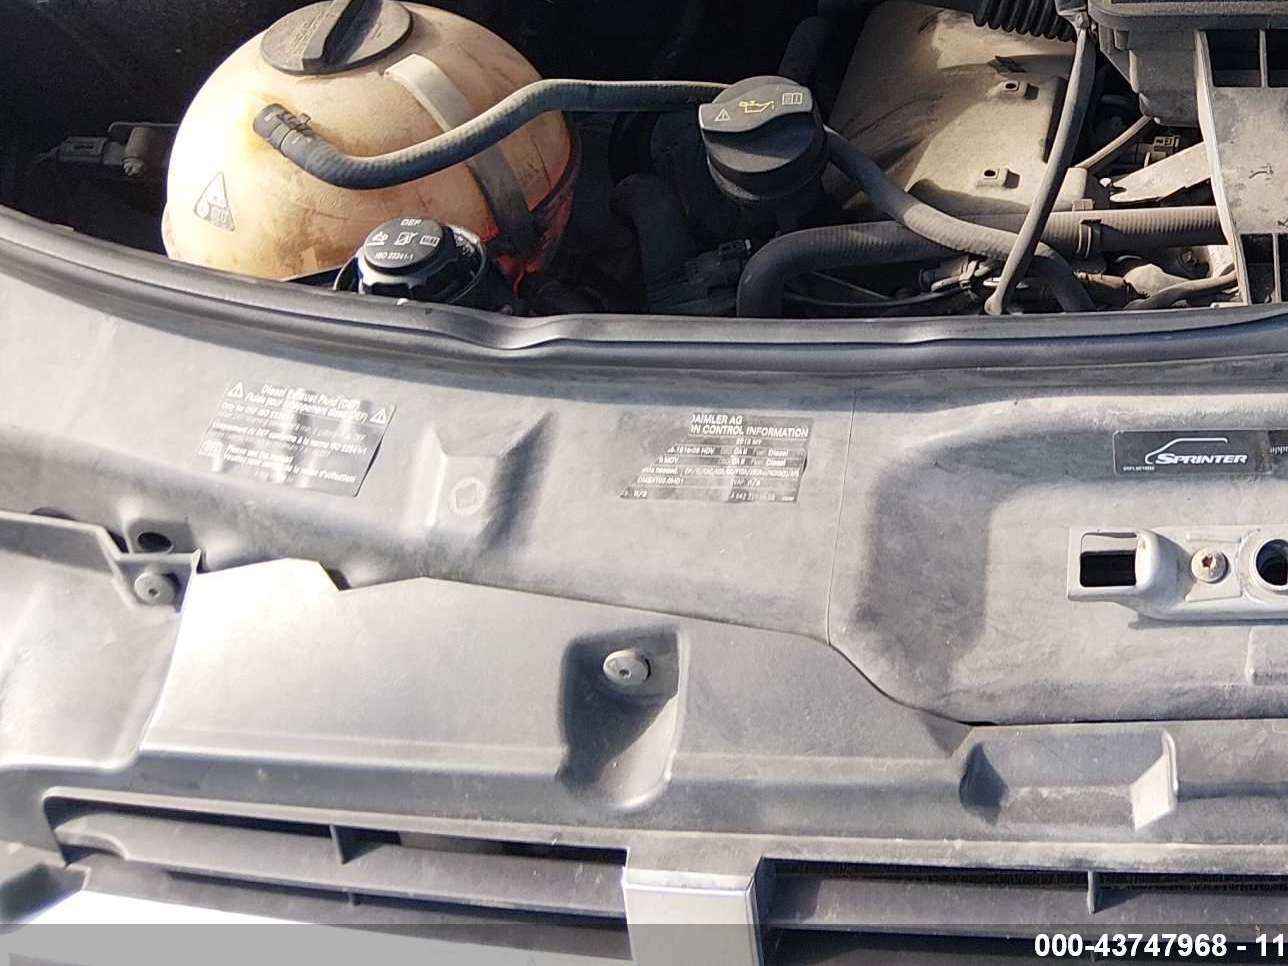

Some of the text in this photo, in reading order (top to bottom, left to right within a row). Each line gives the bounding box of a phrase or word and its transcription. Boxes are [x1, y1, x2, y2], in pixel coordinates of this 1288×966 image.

[400, 218, 422, 226] DEF
[260, 384, 287, 397] Diesel
[317, 394, 339, 408] Fluid
[728, 415, 744, 425] AG
[702, 424, 744, 435] CONTROL
[745, 426, 809, 438] INFORMATION
[1155, 452, 1248, 465] SPRINTER
